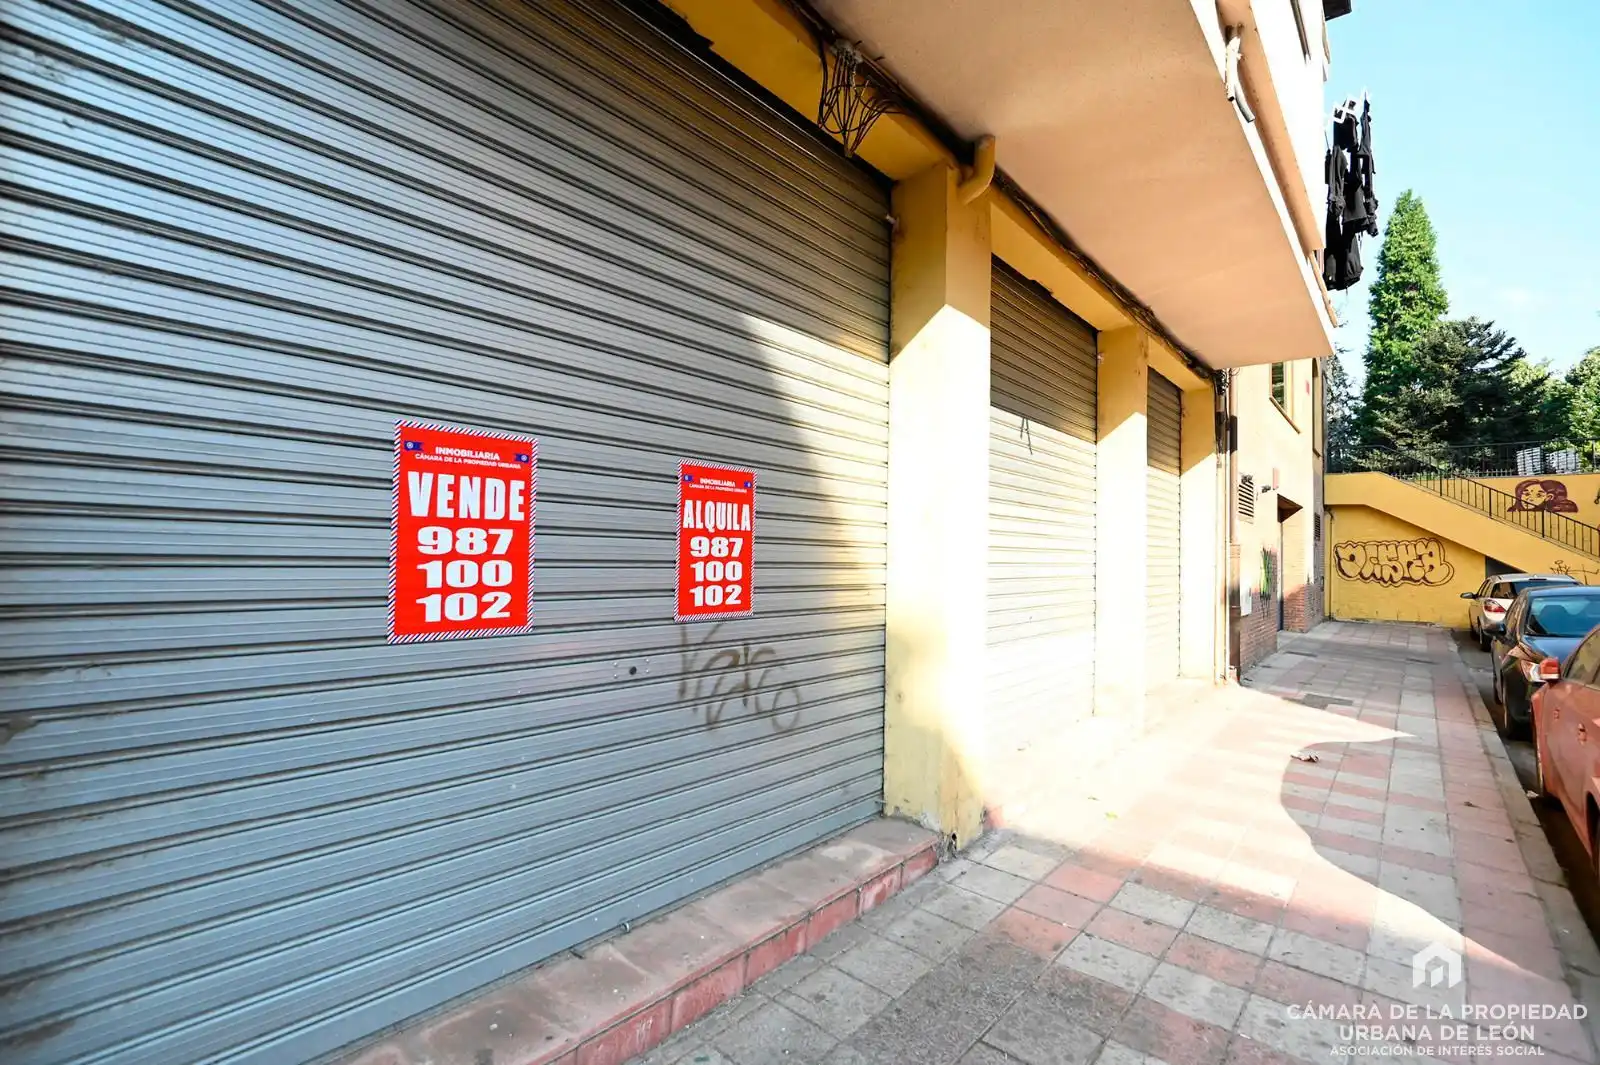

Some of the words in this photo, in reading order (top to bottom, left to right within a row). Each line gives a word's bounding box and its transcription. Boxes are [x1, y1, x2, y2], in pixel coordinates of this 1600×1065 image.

[435, 446, 500, 461] INMOBILIARIA
[463, 458, 497, 468] PROPIEDAD
[407, 471, 525, 521] VENDE
[682, 499, 751, 533] ALQUILA
[417, 526, 514, 555] 987
[690, 535, 744, 558] 987
[416, 560, 513, 589] 100
[690, 561, 743, 582] 100
[415, 591, 512, 623] 102
[689, 584, 742, 607] 102
